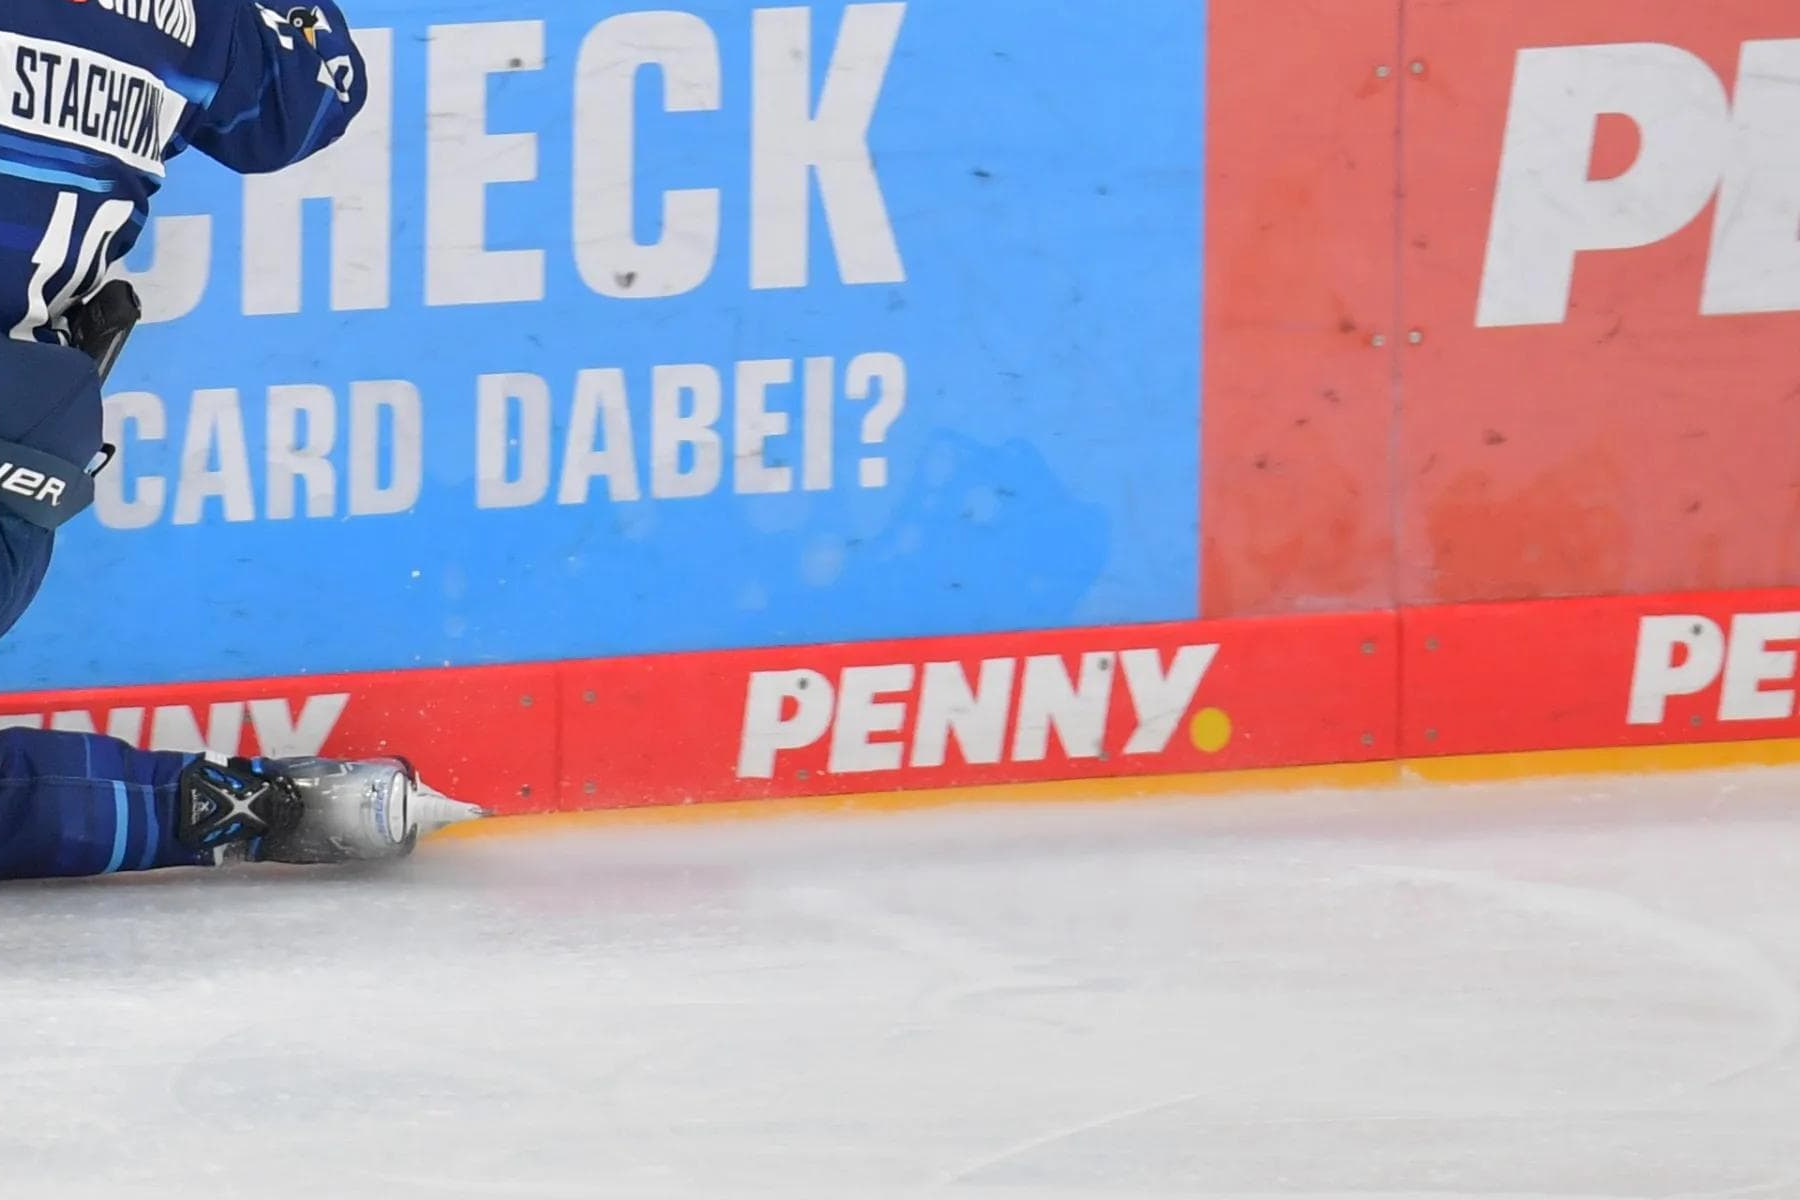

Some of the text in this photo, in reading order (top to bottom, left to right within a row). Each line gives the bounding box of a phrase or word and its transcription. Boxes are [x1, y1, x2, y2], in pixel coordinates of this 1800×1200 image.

[93, 352, 906, 530] CARD DABEI?
[736, 643, 1220, 779] PENNY
